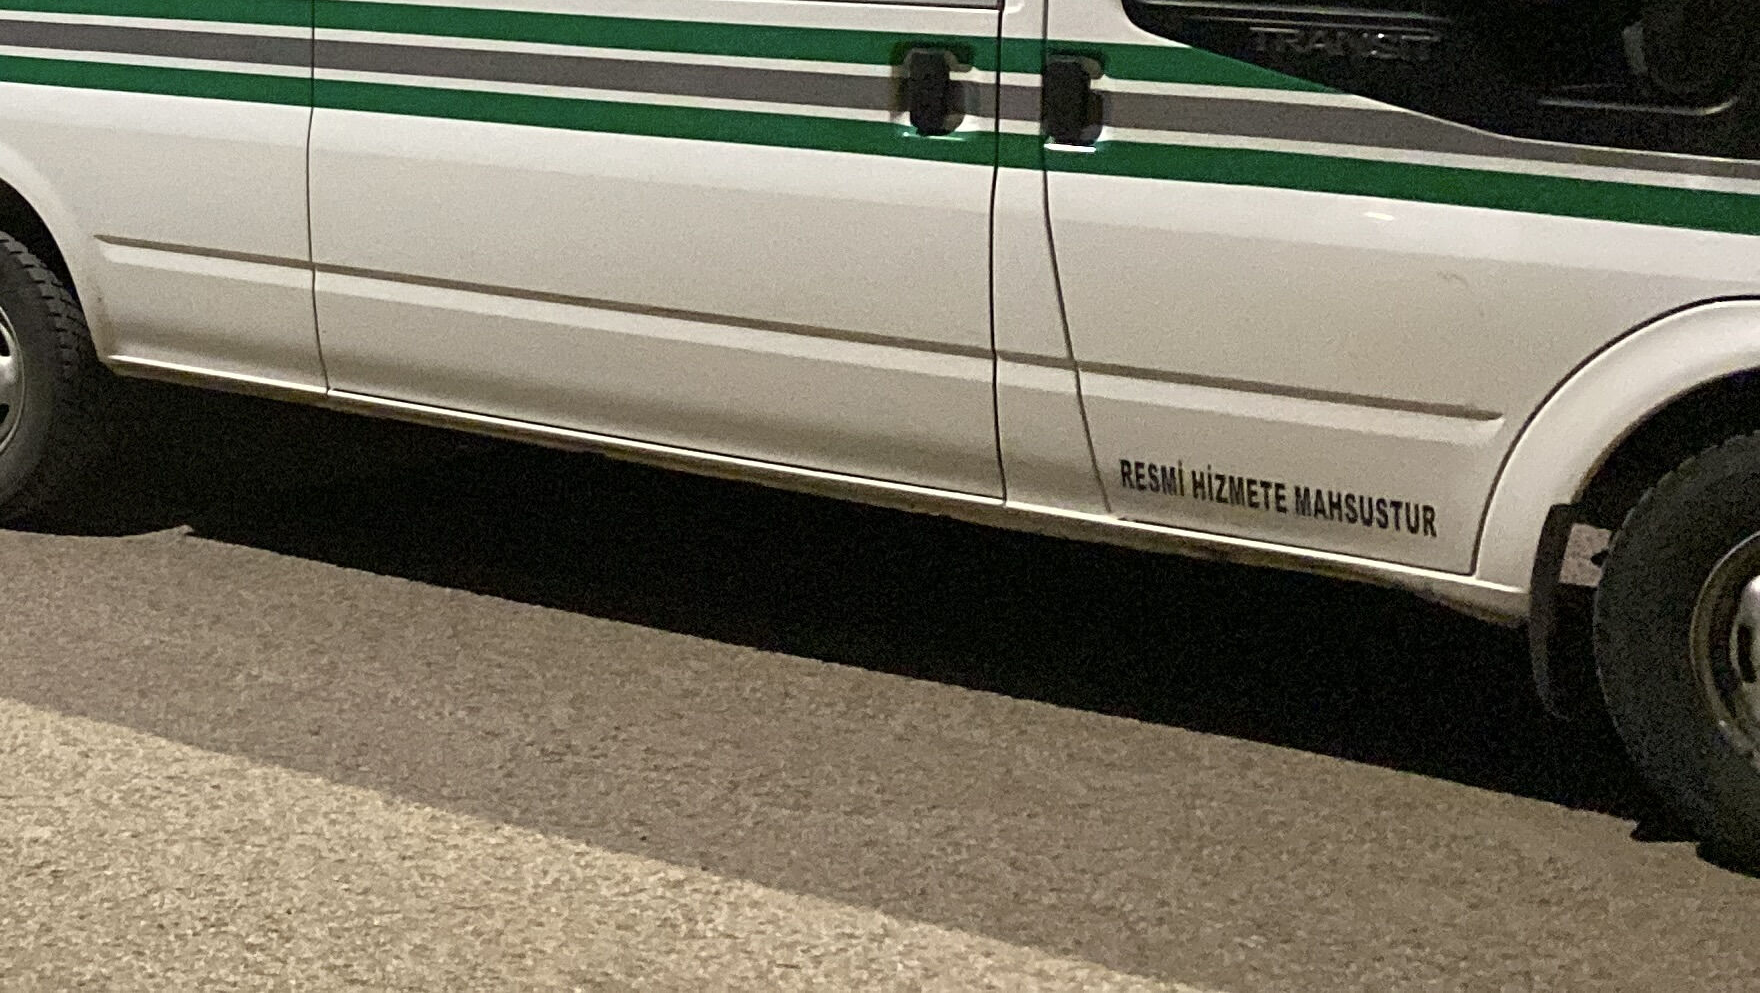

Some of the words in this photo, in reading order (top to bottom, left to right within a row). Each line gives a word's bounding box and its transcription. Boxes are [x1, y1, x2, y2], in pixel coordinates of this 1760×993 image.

[1119, 458, 1185, 497] RESMİ
[1191, 463, 1288, 514] HİZMETE
[1294, 485, 1438, 538] MAHSUSTUR
